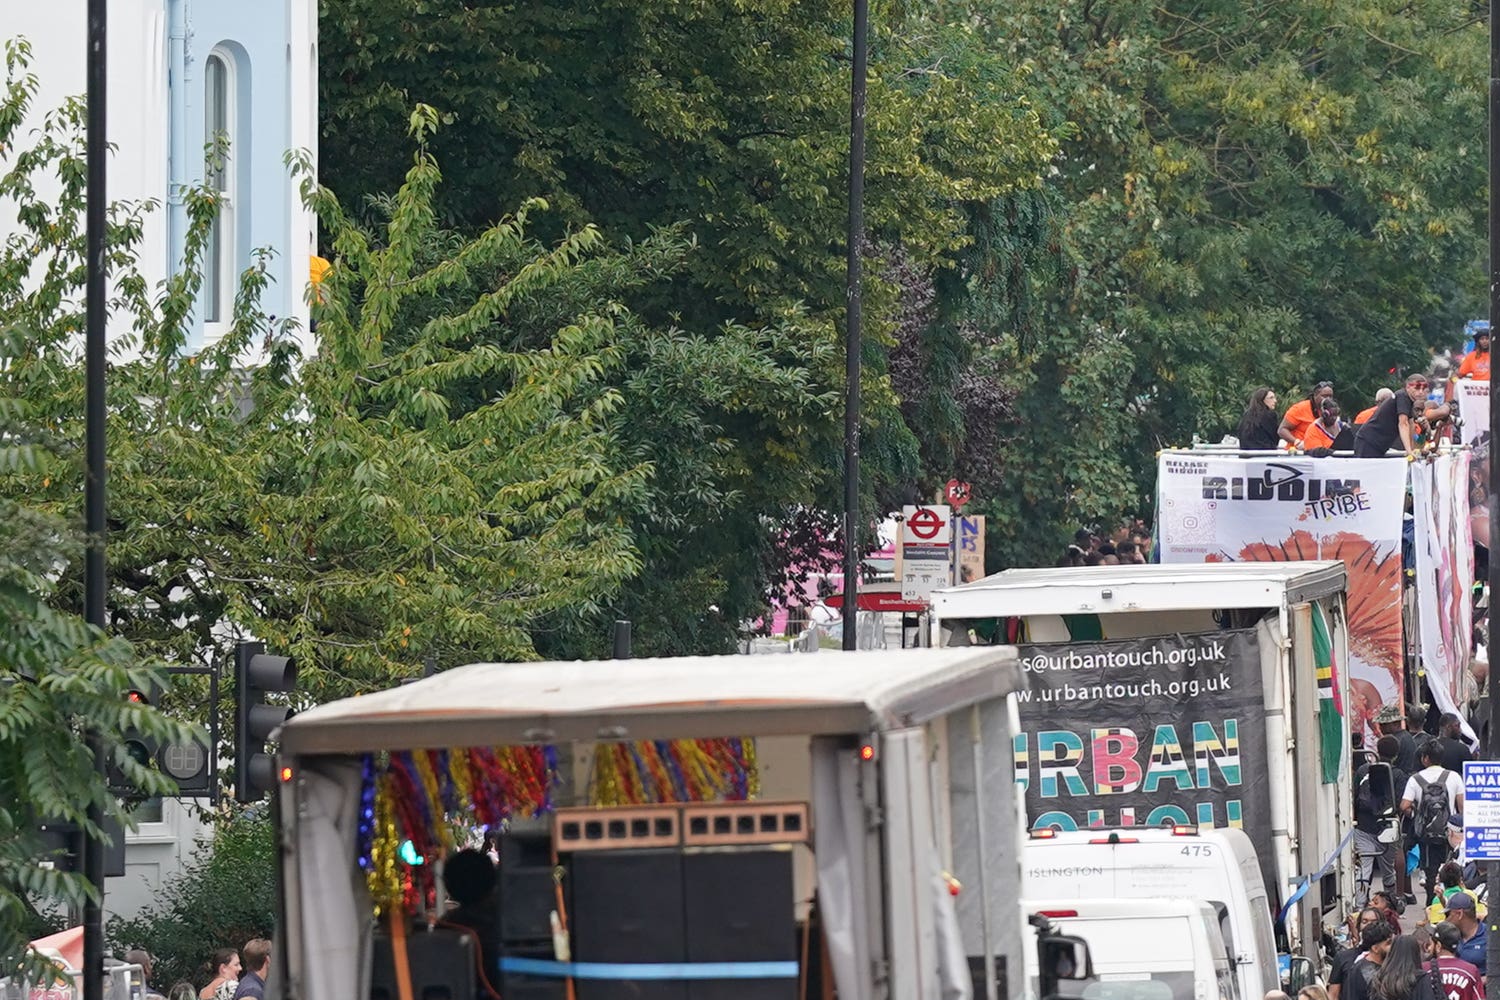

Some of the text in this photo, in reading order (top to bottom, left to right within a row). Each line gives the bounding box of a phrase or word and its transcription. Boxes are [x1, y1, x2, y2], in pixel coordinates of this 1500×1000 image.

[1202, 475, 1361, 502] RIDDIM
[1305, 492, 1371, 520] TRIBE
[1017, 673, 1232, 703] w.urbantouch.org.uk
[1468, 766, 1484, 774] SUN
[1180, 844, 1212, 857] 475
[1029, 866, 1103, 878] ISLINGTON
